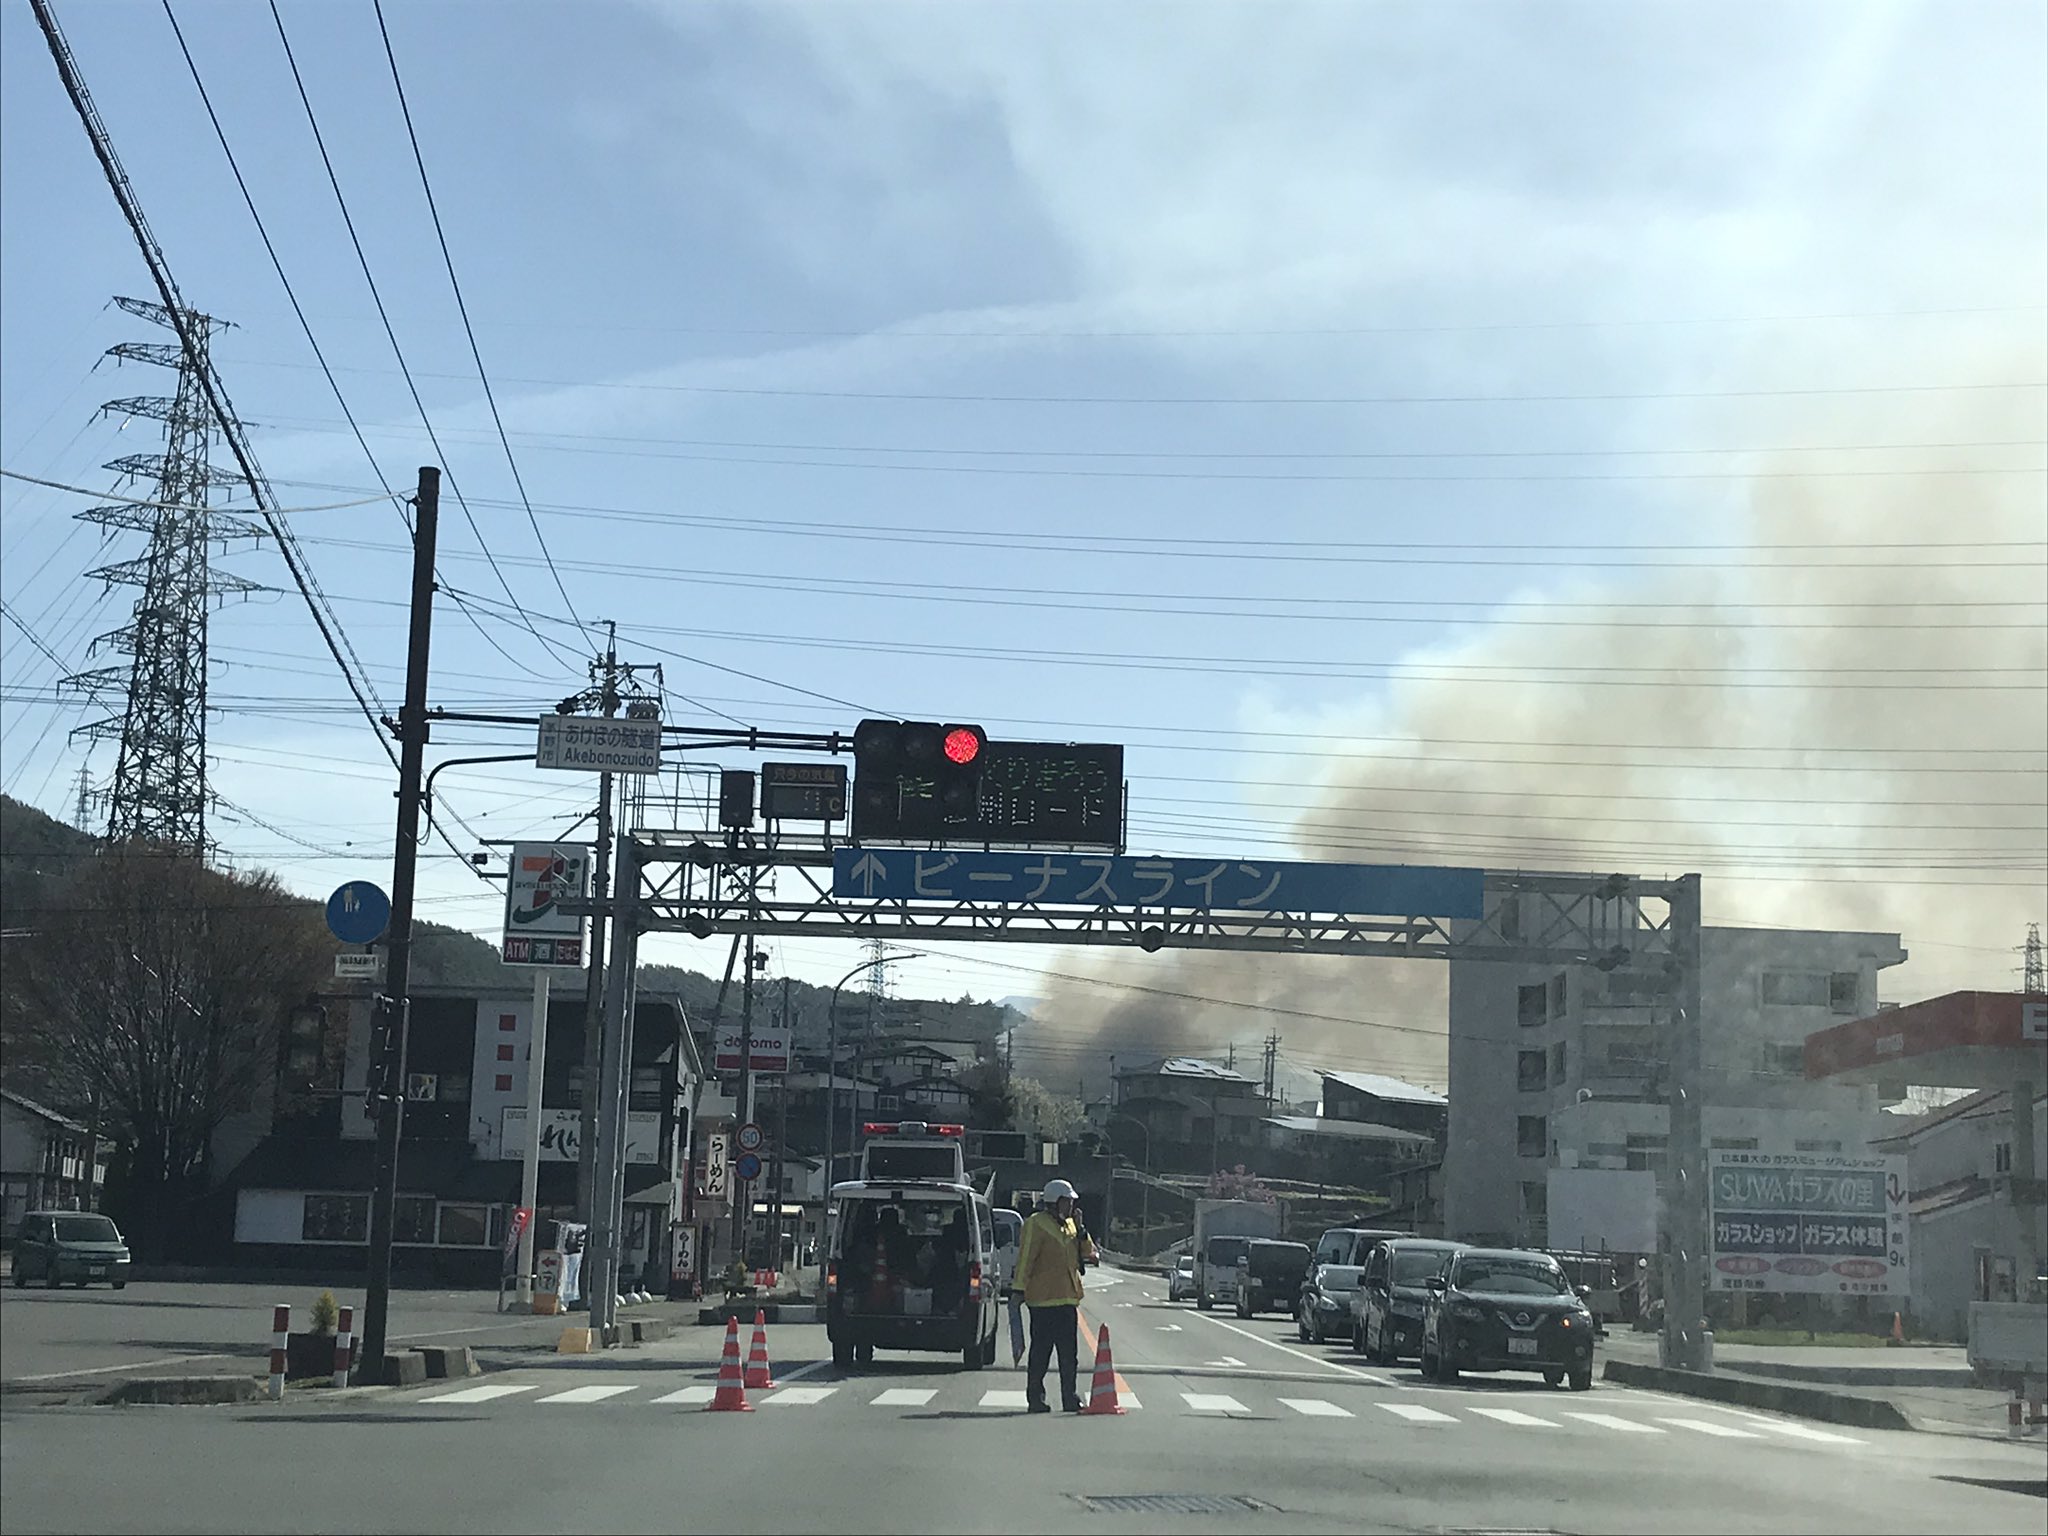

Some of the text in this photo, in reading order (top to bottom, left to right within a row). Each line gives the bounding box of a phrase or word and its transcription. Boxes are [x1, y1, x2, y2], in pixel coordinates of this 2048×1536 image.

[565, 725, 655, 750] あけぼの隧道
[564, 747, 654, 767] Akebonozuido
[913, 854, 1283, 908] ビーナスライン
[505, 941, 529, 958] ATM
[534, 943, 551, 960] 酒
[724, 1036, 782, 1049] doomo
[743, 1131, 757, 1144] 50
[708, 1136, 723, 1193] らーめん
[1717, 1222, 1799, 1244] ガラスショップ
[1804, 1224, 1885, 1248] ガラス体験
[677, 1231, 690, 1268] らーめん
